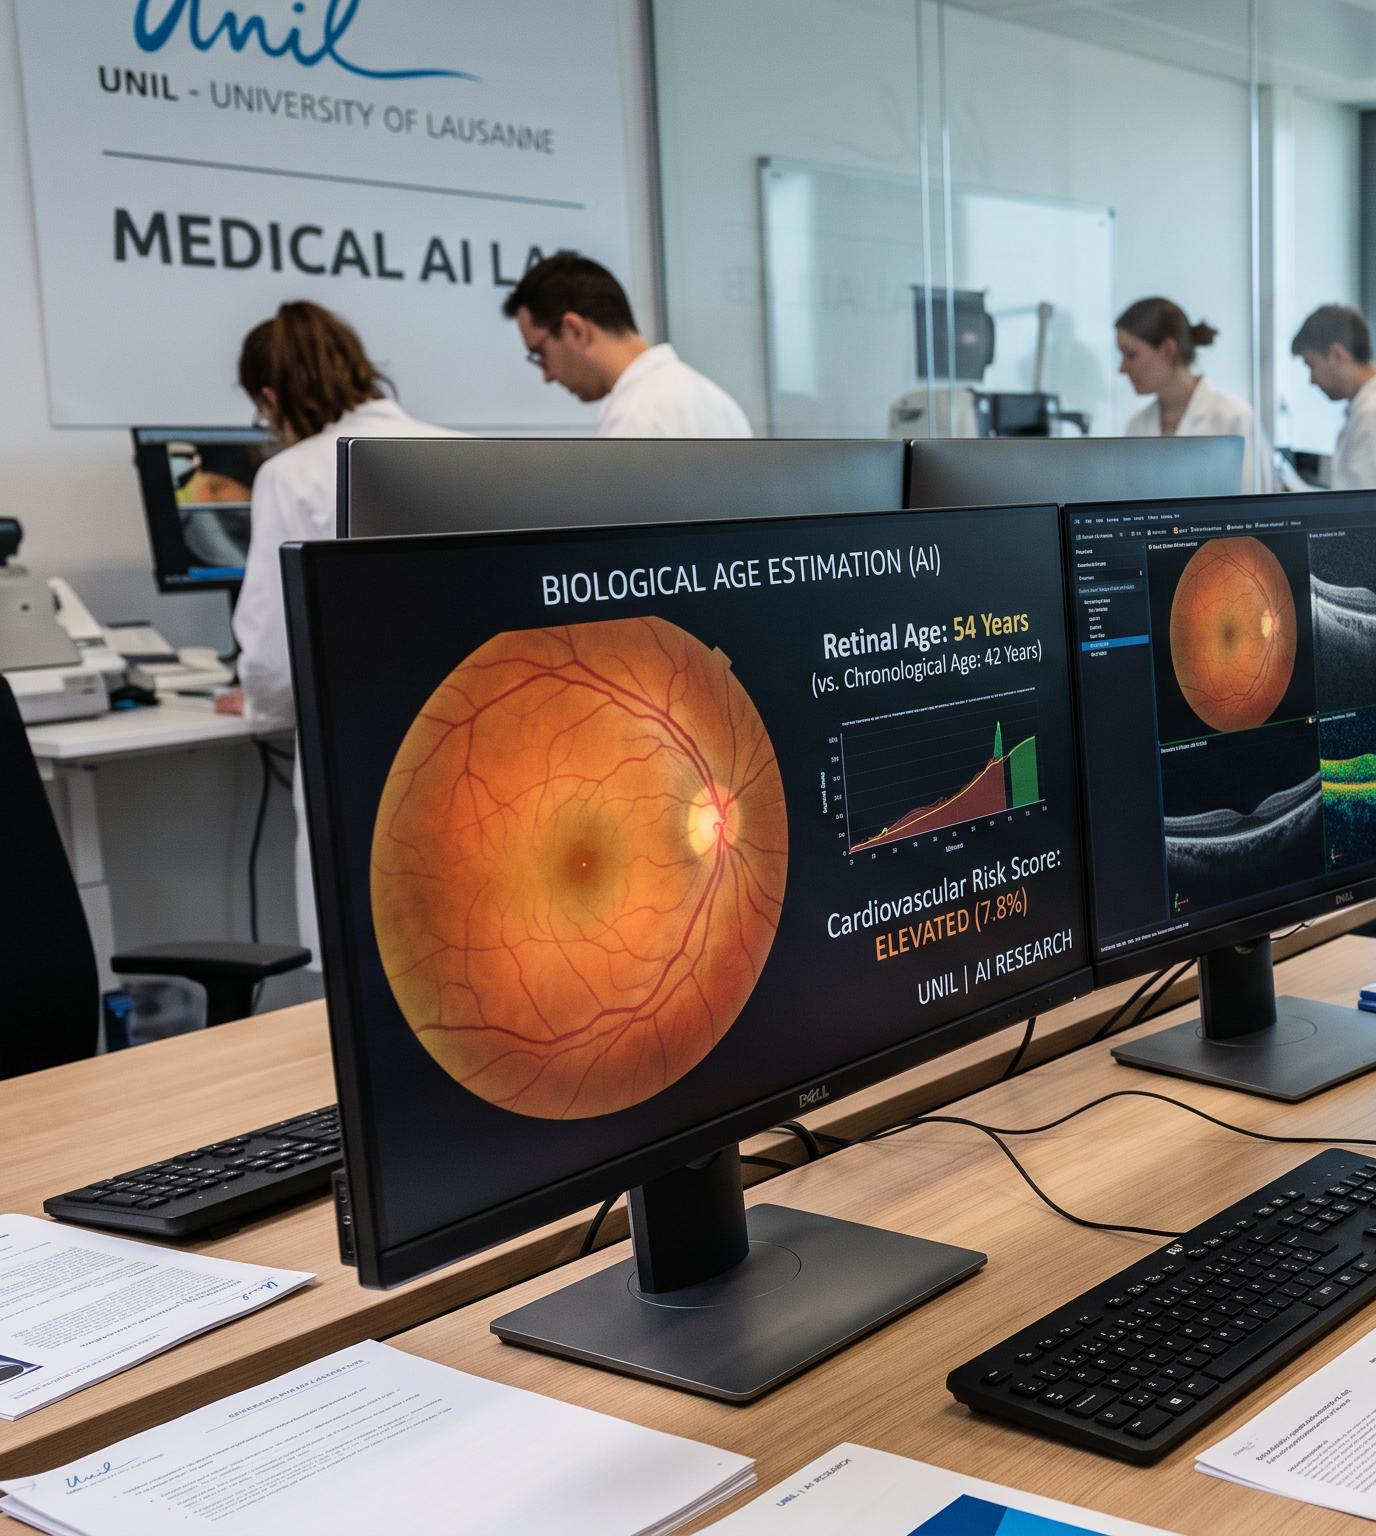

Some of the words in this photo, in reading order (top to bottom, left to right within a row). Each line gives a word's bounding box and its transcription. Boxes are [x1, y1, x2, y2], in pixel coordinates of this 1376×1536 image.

[98, 65, 179, 101] UNIL
[210, 80, 375, 128] UNIVERSITY
[383, 105, 417, 134] OF
[426, 112, 554, 154] LAUSANNE
[114, 207, 405, 281] MEDICAL
[420, 236, 472, 285] AI
[541, 564, 706, 606] BIOLOGICAL
[713, 559, 762, 591] AGE
[768, 548, 902, 585] ESTIMATION
[909, 543, 941, 578] (AI)
[812, 672, 840, 699] (vs.
[844, 654, 947, 689] Chronological
[950, 652, 981, 675] Age:
[984, 647, 1002, 666] 42
[1004, 639, 1042, 663] Years)
[823, 623, 898, 660] Retinal
[904, 622, 948, 652] Age:
[953, 615, 976, 641] 54
[981, 612, 1030, 637] Years
[827, 877, 967, 938] Cardiovascular
[972, 860, 1007, 893] Risk
[1010, 849, 1061, 881] Score:
[875, 908, 969, 961] ELEVATED
[974, 886, 1028, 933] (7.8%)
[918, 971, 959, 1005] UNIL
[975, 958, 991, 985] AI
[996, 928, 1073, 977] RESEARCH
